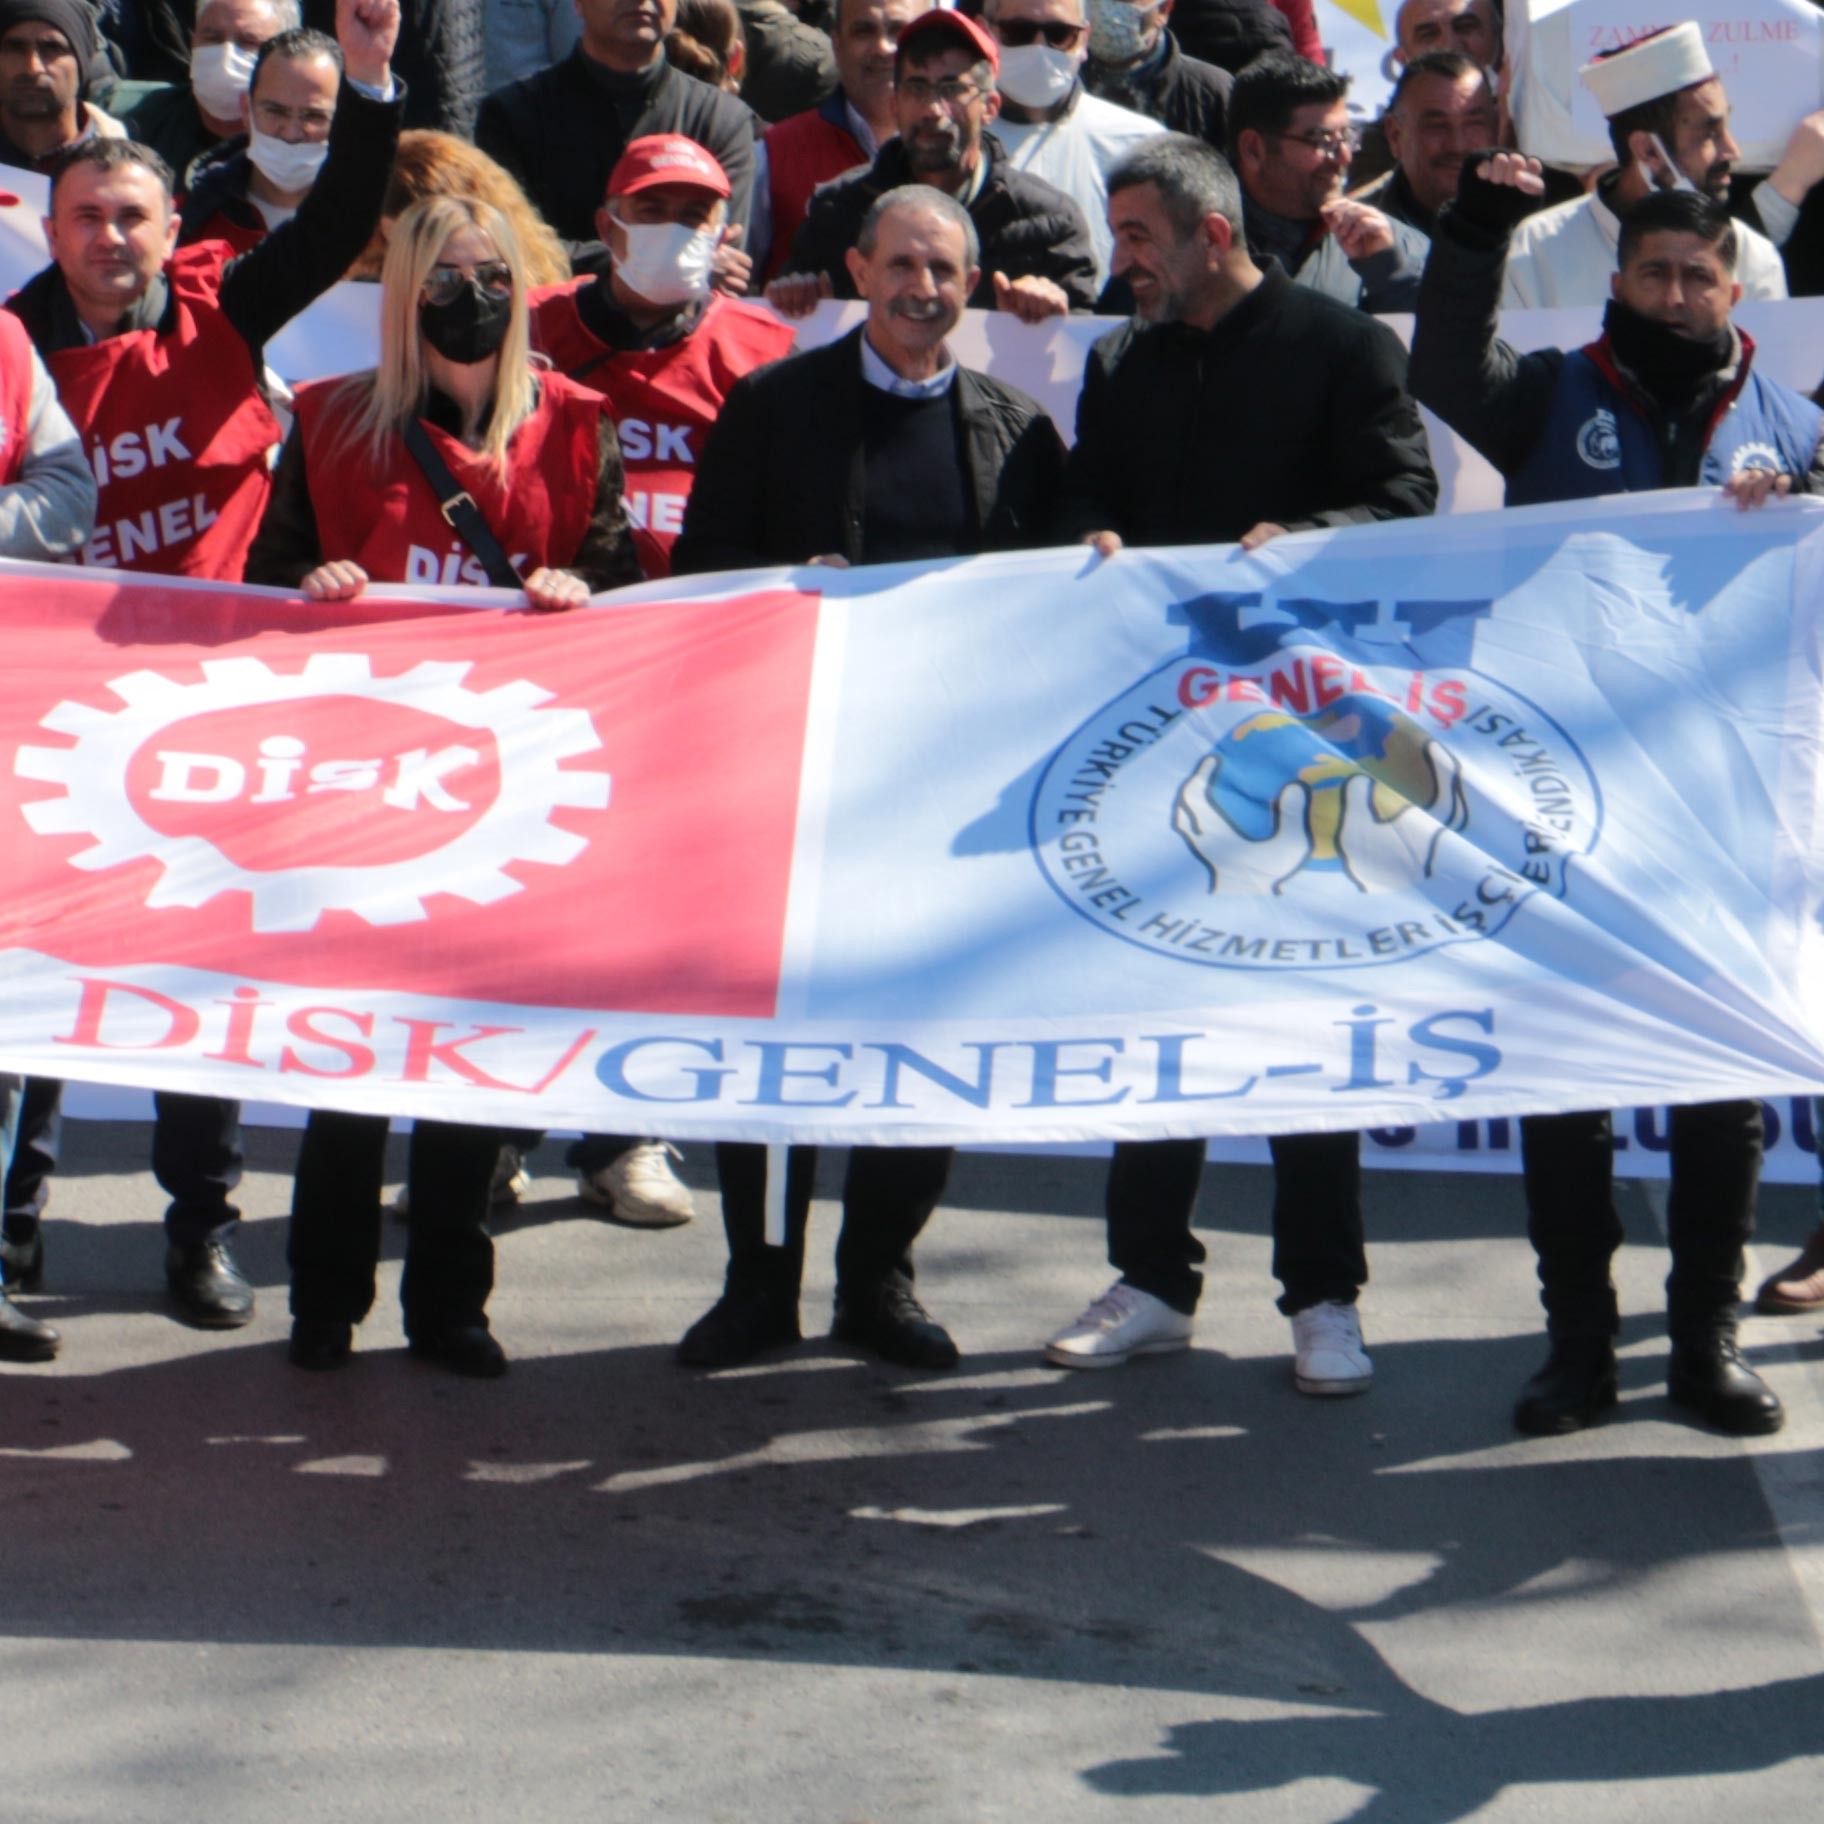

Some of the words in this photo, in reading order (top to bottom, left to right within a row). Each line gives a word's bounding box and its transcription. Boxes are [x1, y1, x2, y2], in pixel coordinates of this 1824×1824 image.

[1707, 21, 1800, 43] ZULME
[148, 734, 483, 814] DİSK
[1055, 702, 1183, 826] TÜRKİYE
[1058, 830, 1146, 924] GENEL
[1138, 910, 1434, 963] HİZMETLER
[50, 976, 1504, 1111] DİSK/GENEL-İŞ
